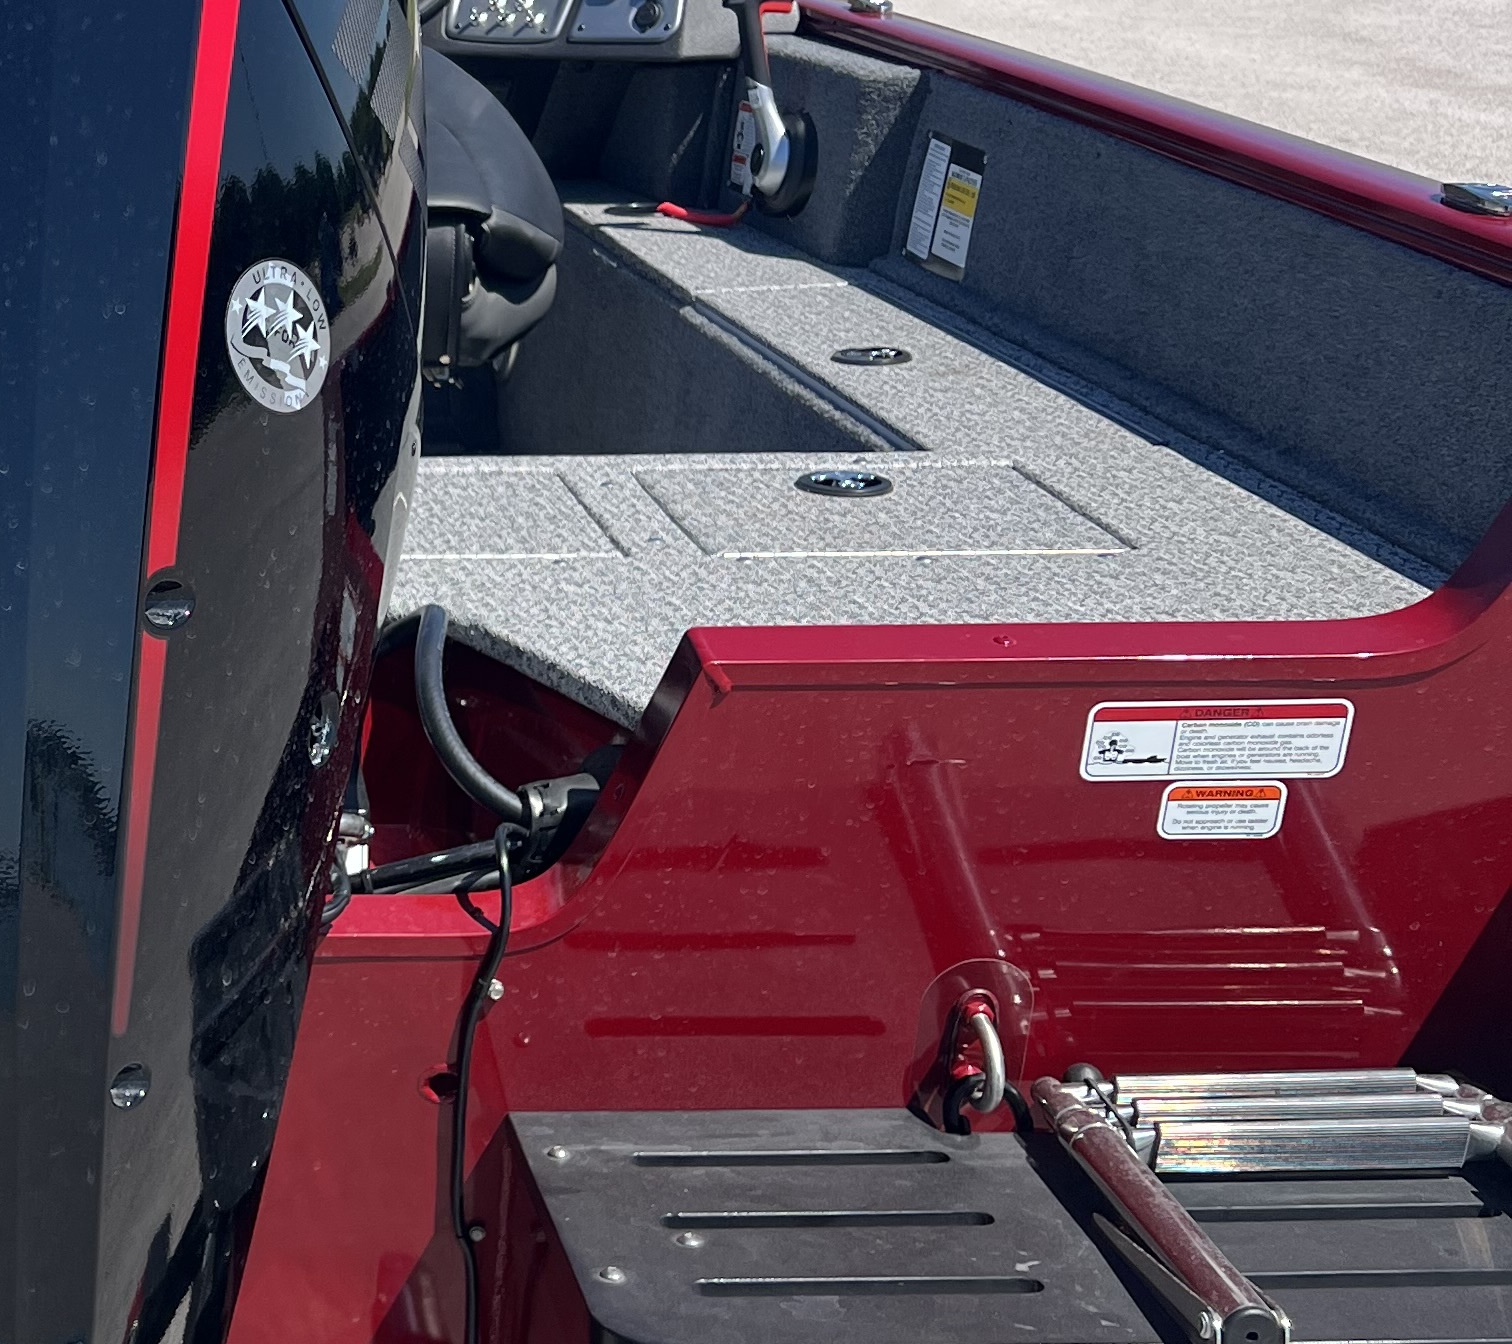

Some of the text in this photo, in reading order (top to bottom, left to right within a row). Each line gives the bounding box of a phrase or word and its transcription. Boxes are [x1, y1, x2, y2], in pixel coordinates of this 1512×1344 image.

[252, 265, 327, 330] ULTRA LOW
[1195, 708, 1250, 717] DANGER
[1195, 789, 1254, 797] WARNING
